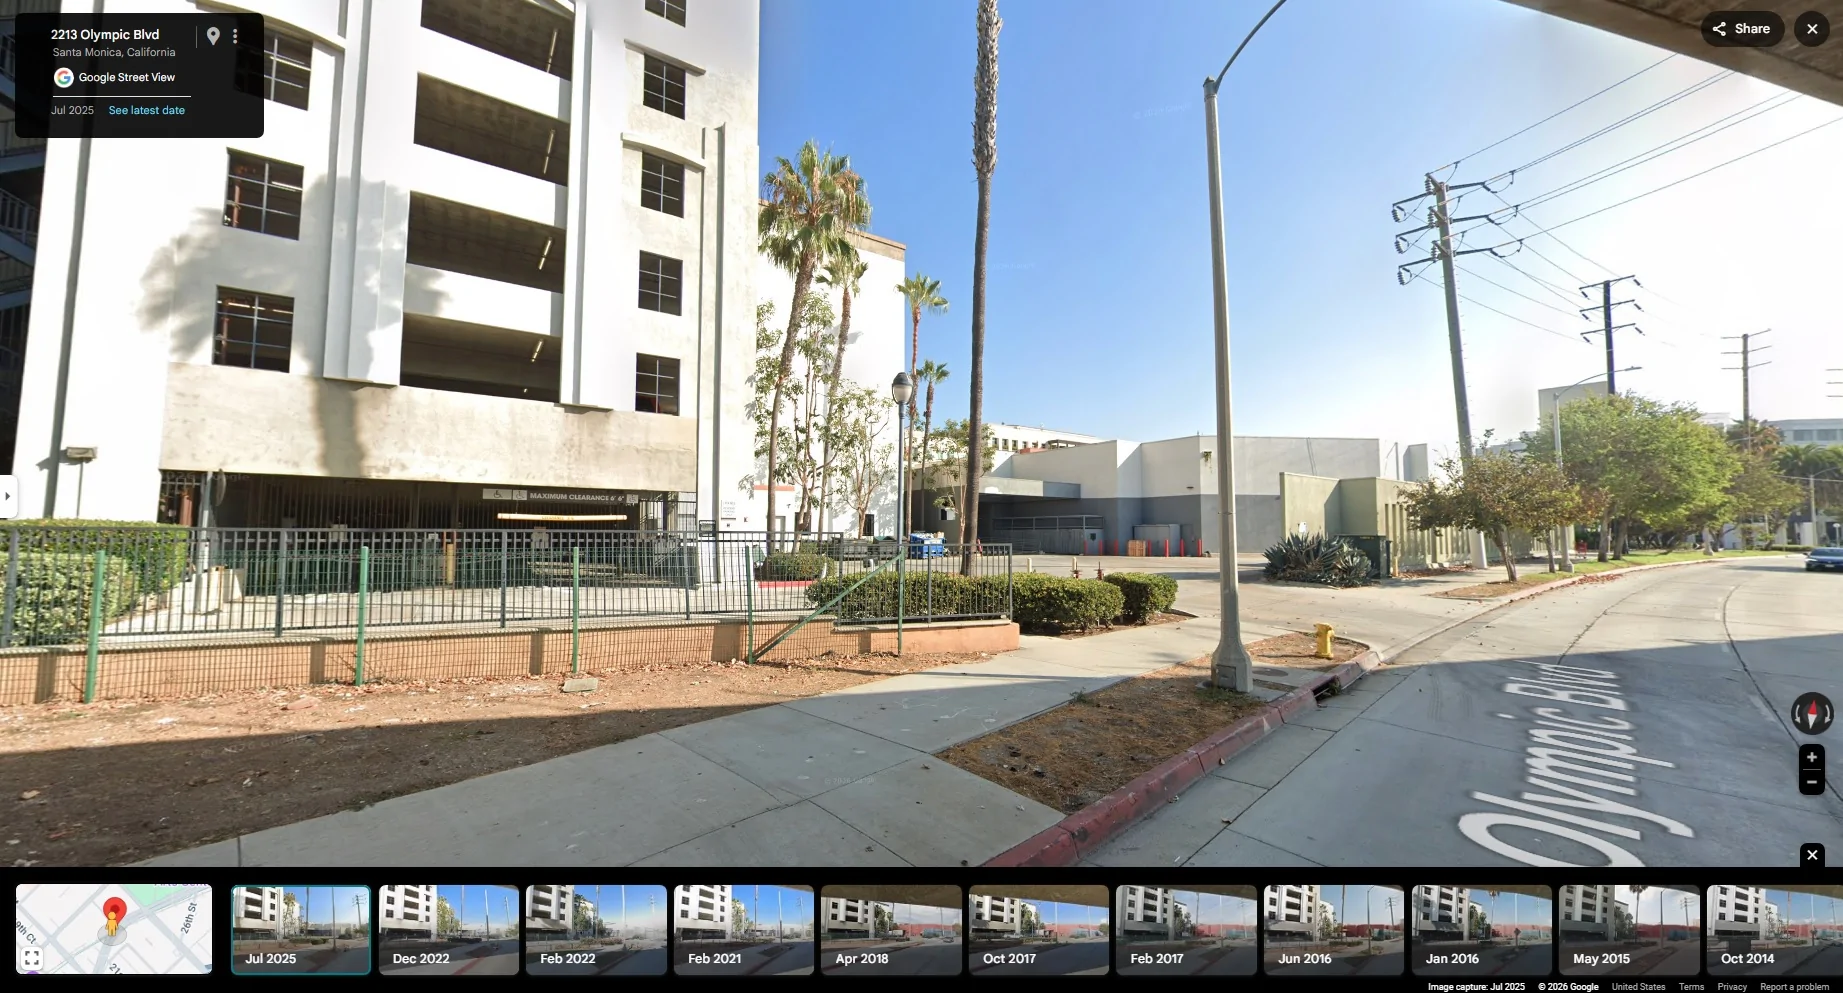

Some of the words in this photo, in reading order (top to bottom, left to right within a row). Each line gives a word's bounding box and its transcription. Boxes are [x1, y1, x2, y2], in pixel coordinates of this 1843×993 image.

[529, 492, 568, 500] MAXIMUM
[1503, 659, 1630, 711] Blvd
[1458, 706, 1696, 867] Olympic
